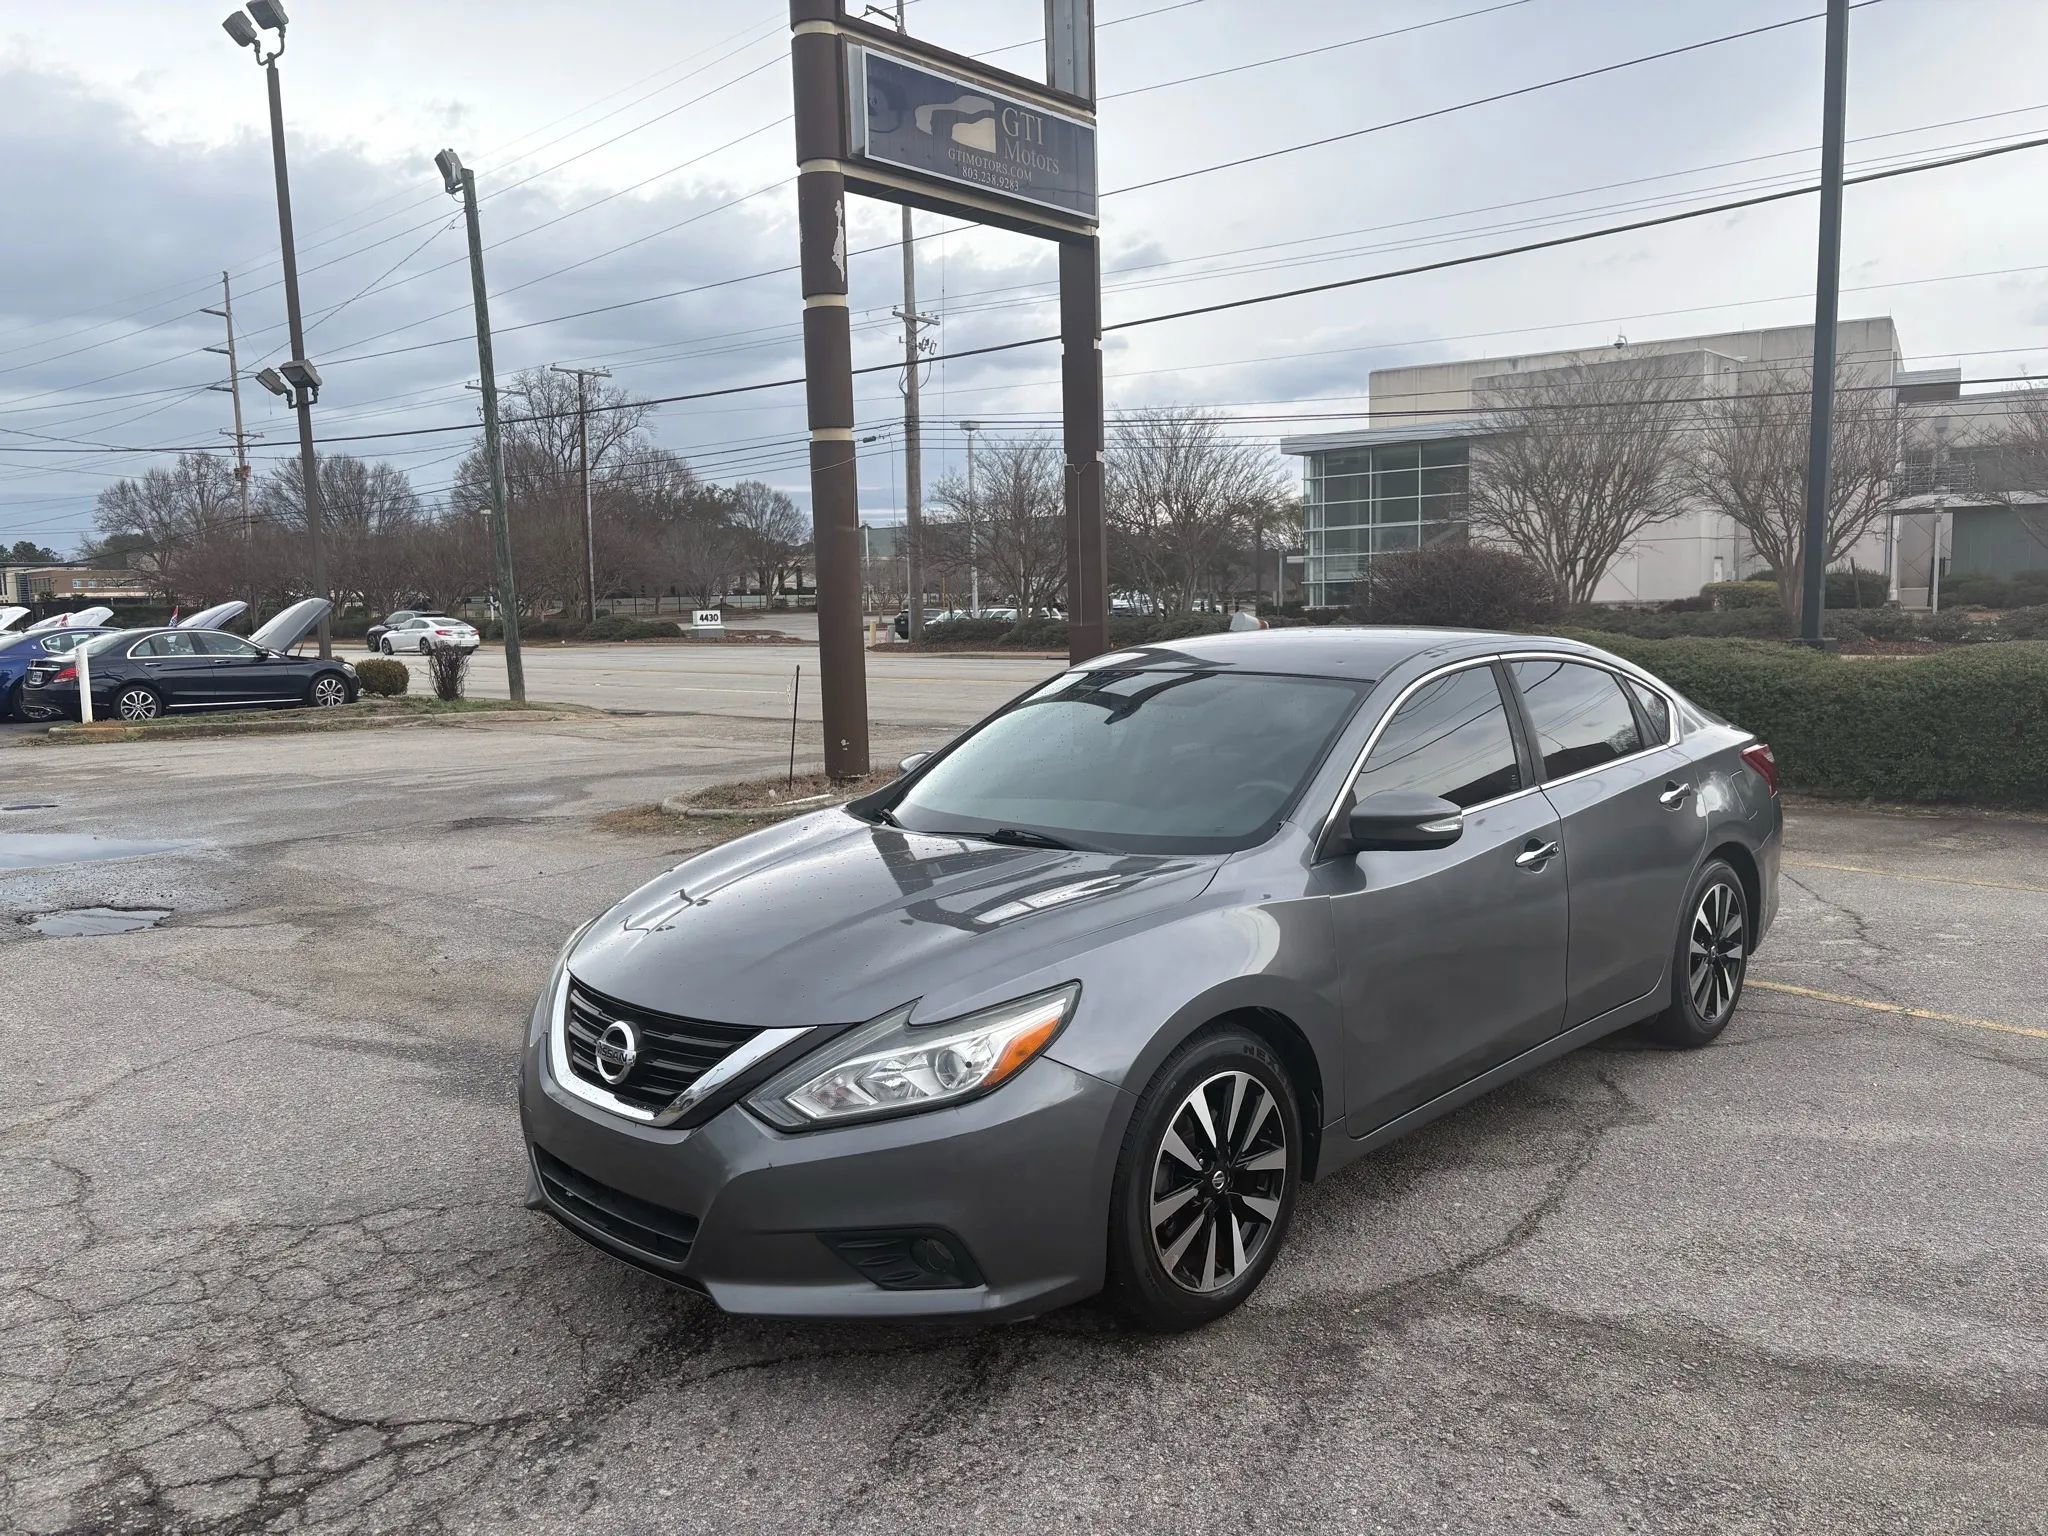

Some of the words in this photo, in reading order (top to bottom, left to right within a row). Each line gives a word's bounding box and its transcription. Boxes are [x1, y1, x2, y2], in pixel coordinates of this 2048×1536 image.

[1002, 107, 1043, 145] GTI
[948, 148, 1032, 182] GTIMOTORS.COM
[1004, 138, 1060, 175] Motors
[962, 166, 1019, 191] 803.238.9283
[699, 614, 719, 622] 4430
